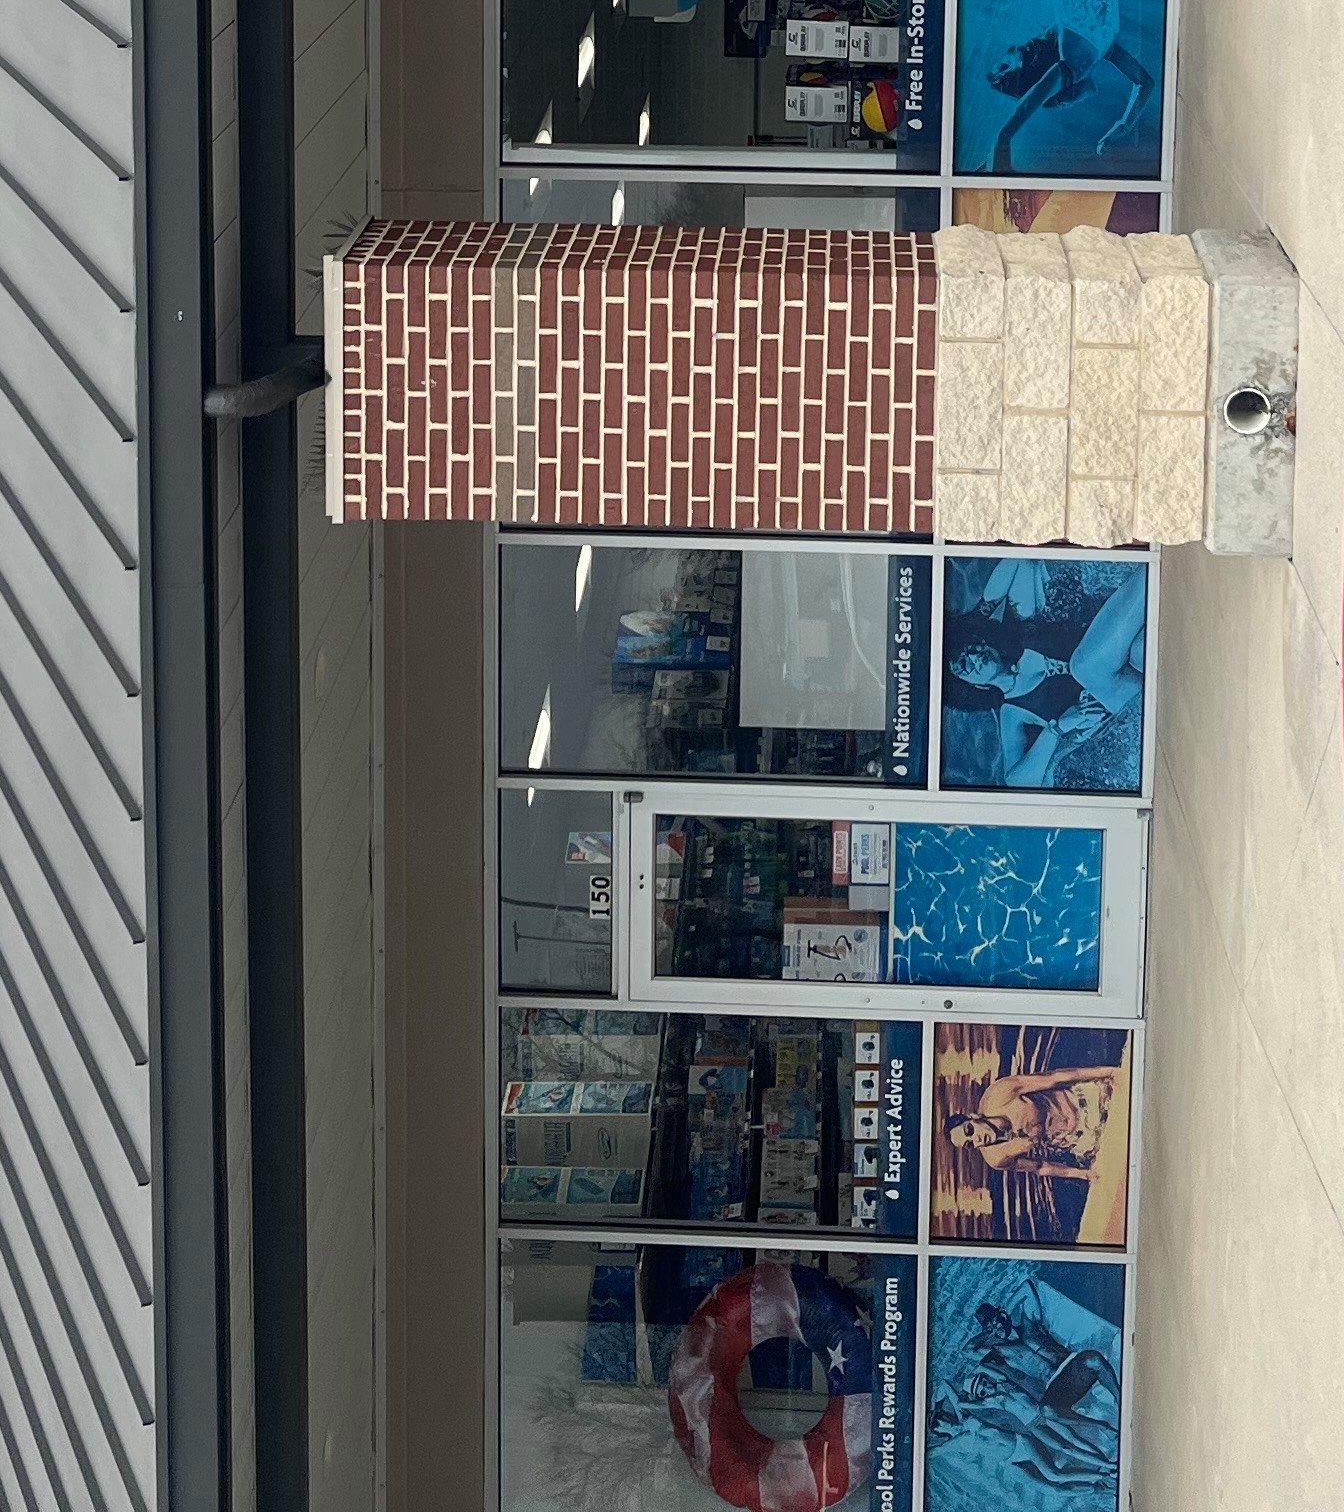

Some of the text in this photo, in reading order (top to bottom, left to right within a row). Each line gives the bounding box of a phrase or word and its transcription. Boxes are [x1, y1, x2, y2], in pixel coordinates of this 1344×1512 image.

[905, 69, 923, 111] Free
[892, 567, 913, 758] Nationwide Services
[591, 877, 610, 916] 150
[884, 1059, 906, 1182] Expert Advice
[880, 1277, 902, 1351] Program
[878, 1355, 897, 1429] Rewards
[877, 1432, 895, 1480] Perks
